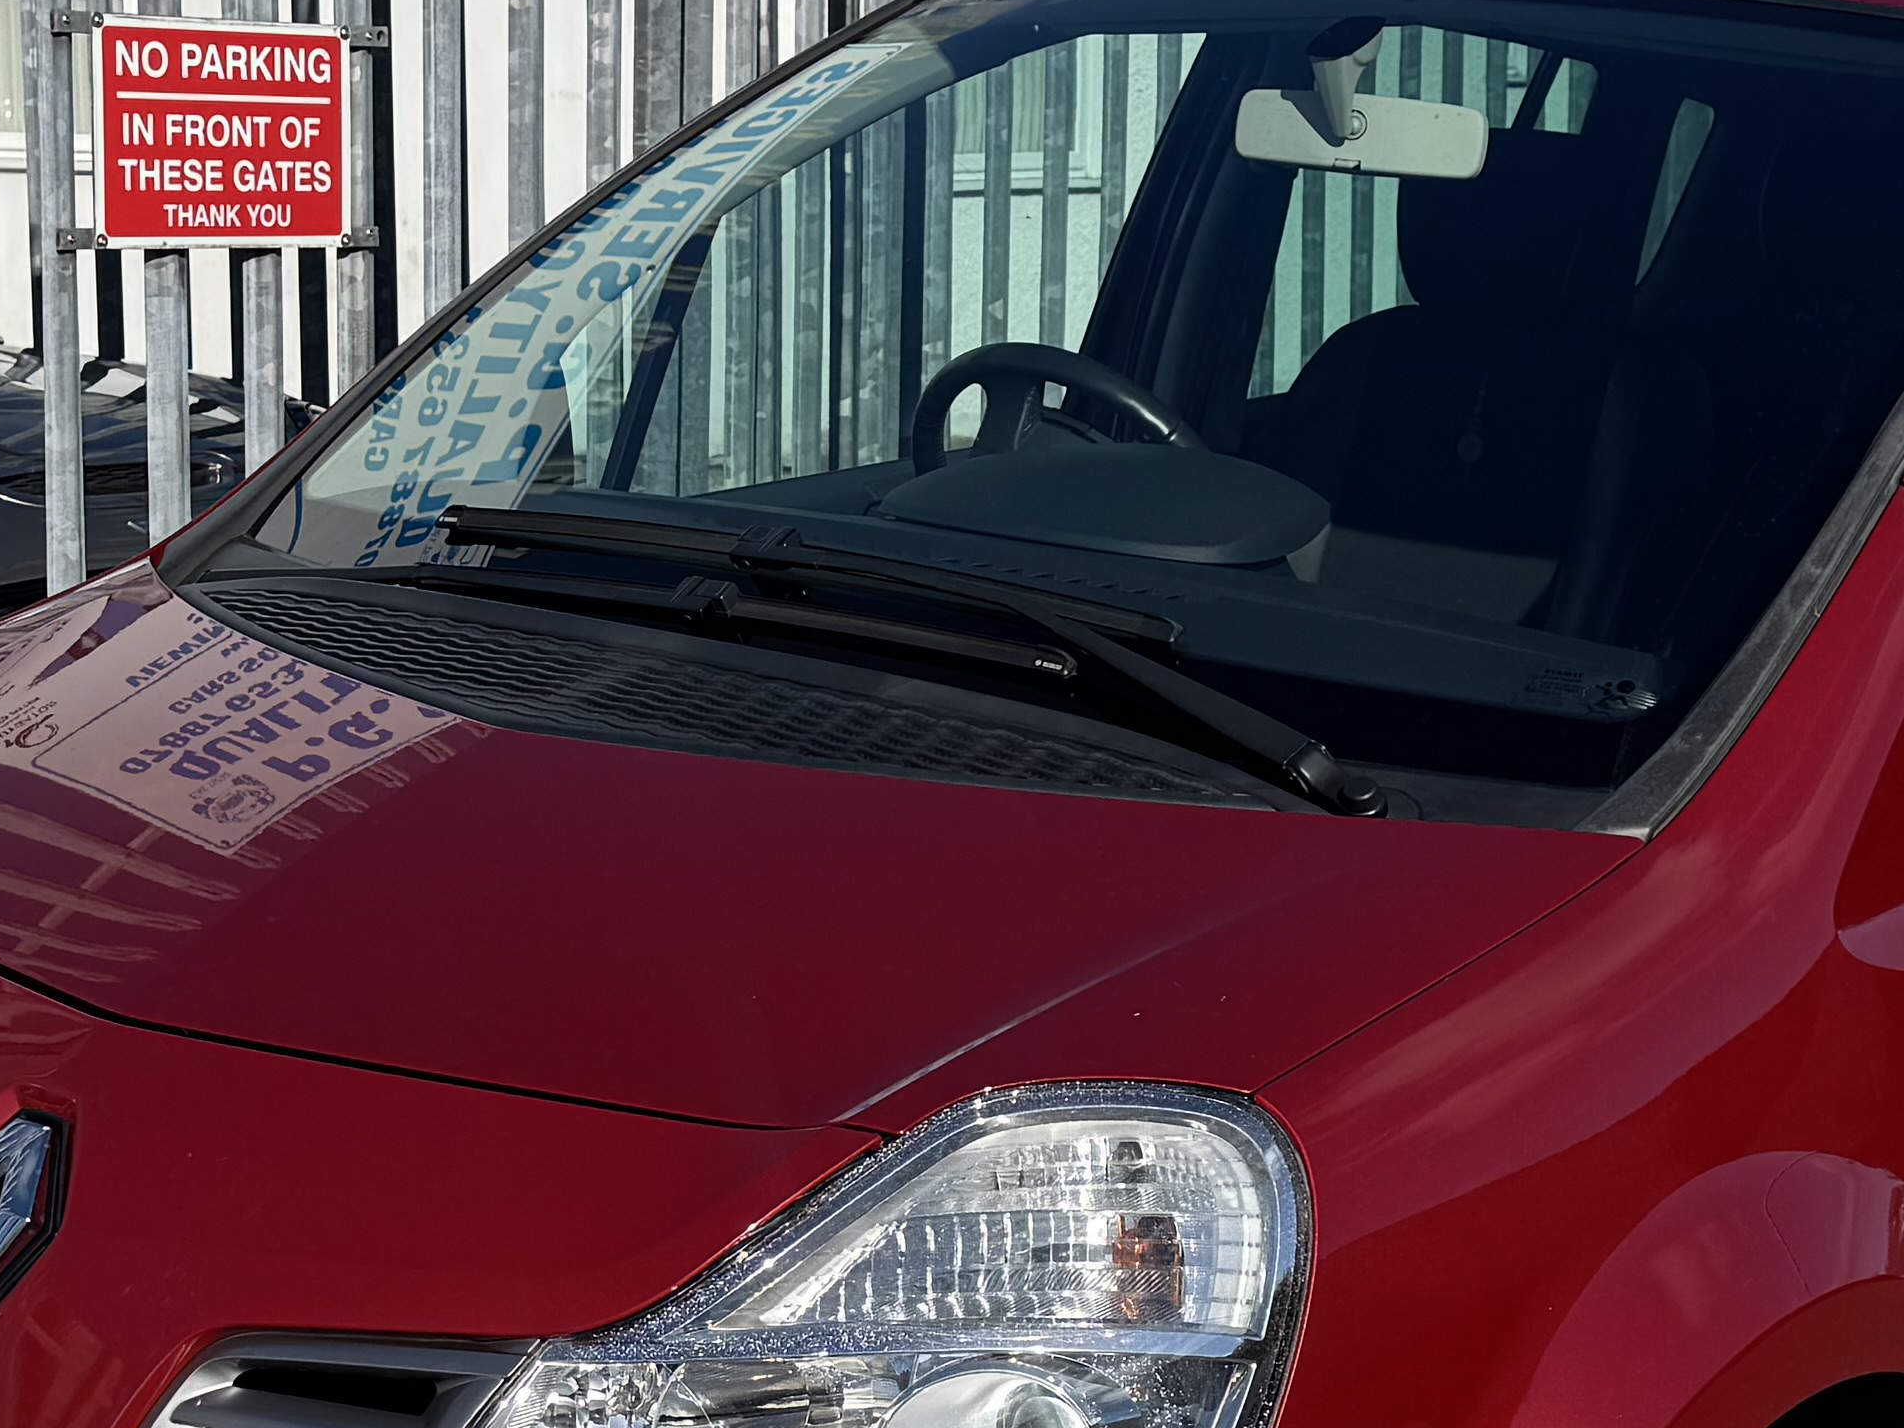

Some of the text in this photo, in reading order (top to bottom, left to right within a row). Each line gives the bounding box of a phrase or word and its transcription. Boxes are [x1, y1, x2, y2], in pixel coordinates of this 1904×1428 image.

[115, 40, 332, 84] NO PARKING
[122, 113, 321, 149] IN FRONT OF
[117, 158, 332, 193] THESE GATES
[163, 204, 291, 228] THANK YOU
